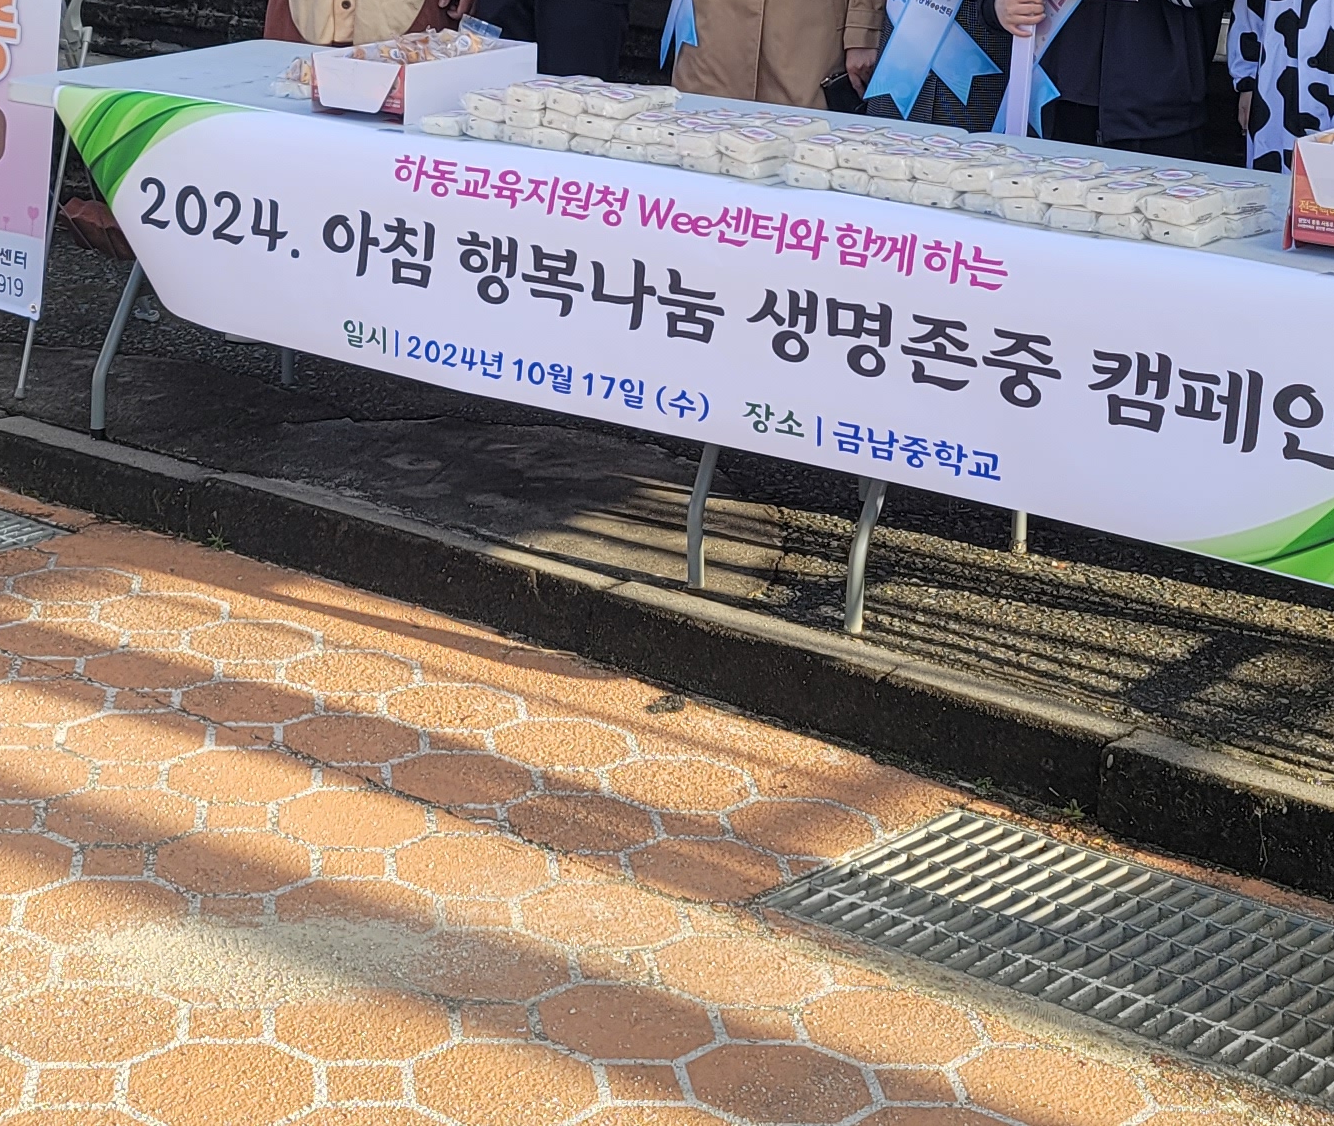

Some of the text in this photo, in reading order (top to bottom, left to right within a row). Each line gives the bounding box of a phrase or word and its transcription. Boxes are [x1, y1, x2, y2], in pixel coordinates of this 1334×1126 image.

[140, 176, 301, 260] 2024.
[322, 209, 438, 289] 아침
[457, 229, 726, 345] 행복나눔
[746, 287, 1062, 410] 생명존중
[394, 153, 1009, 291] 하동교육지원청 Wee센터와 함께 하는
[342, 317, 1003, 482] 일시 2024년 10월 17일 (수) 장소 금남중학교
